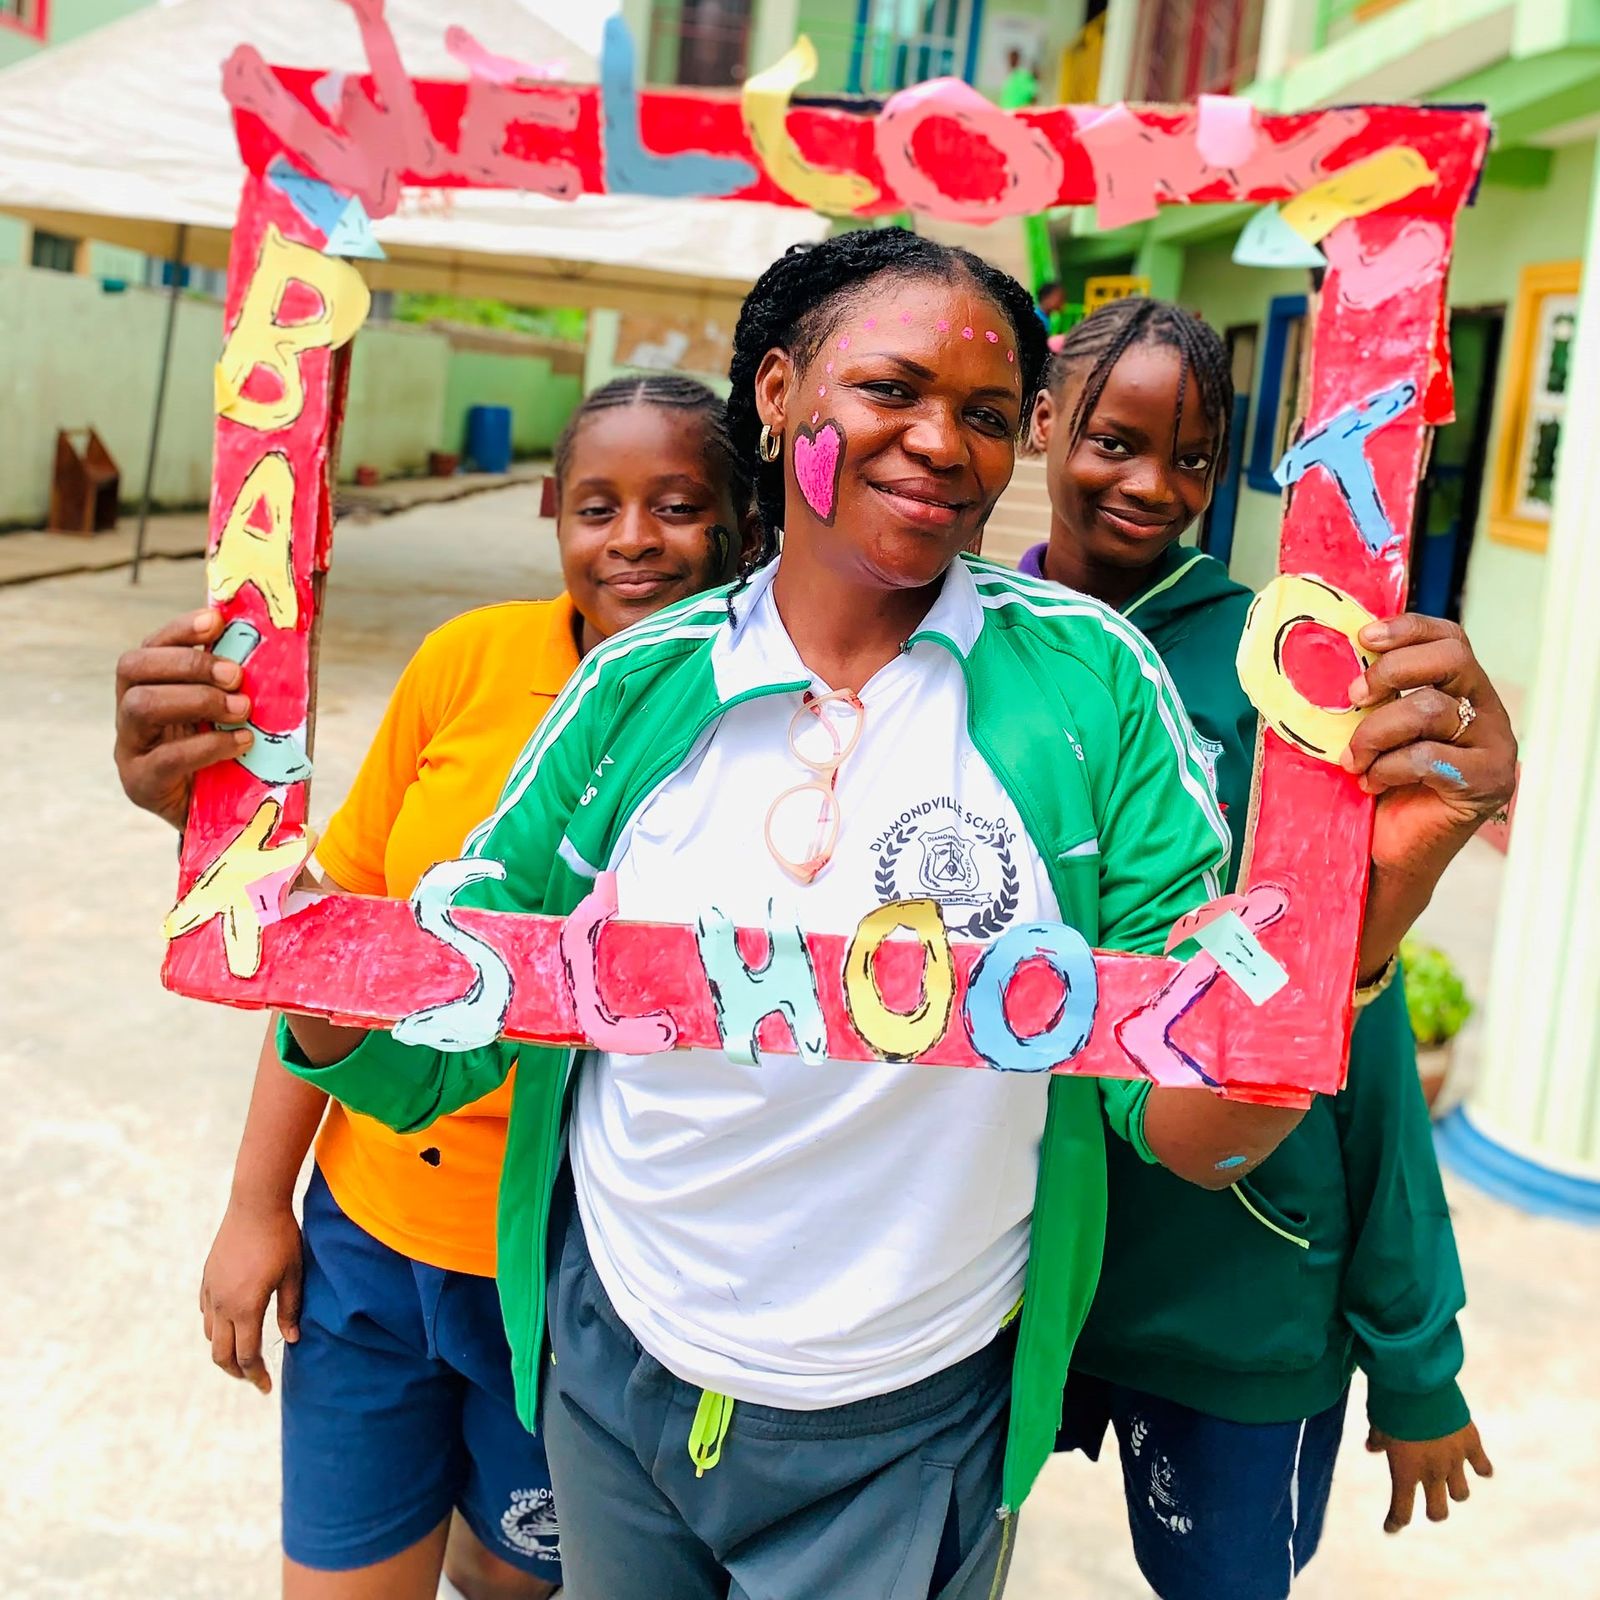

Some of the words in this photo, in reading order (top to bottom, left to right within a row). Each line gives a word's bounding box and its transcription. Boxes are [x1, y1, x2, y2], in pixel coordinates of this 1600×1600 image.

[1236, 378, 1417, 767] TO
[869, 796, 963, 853] DIAMONDVILLE
[964, 812, 1017, 844] SCHOLS
[390, 856, 1291, 1089] SCHOOL
